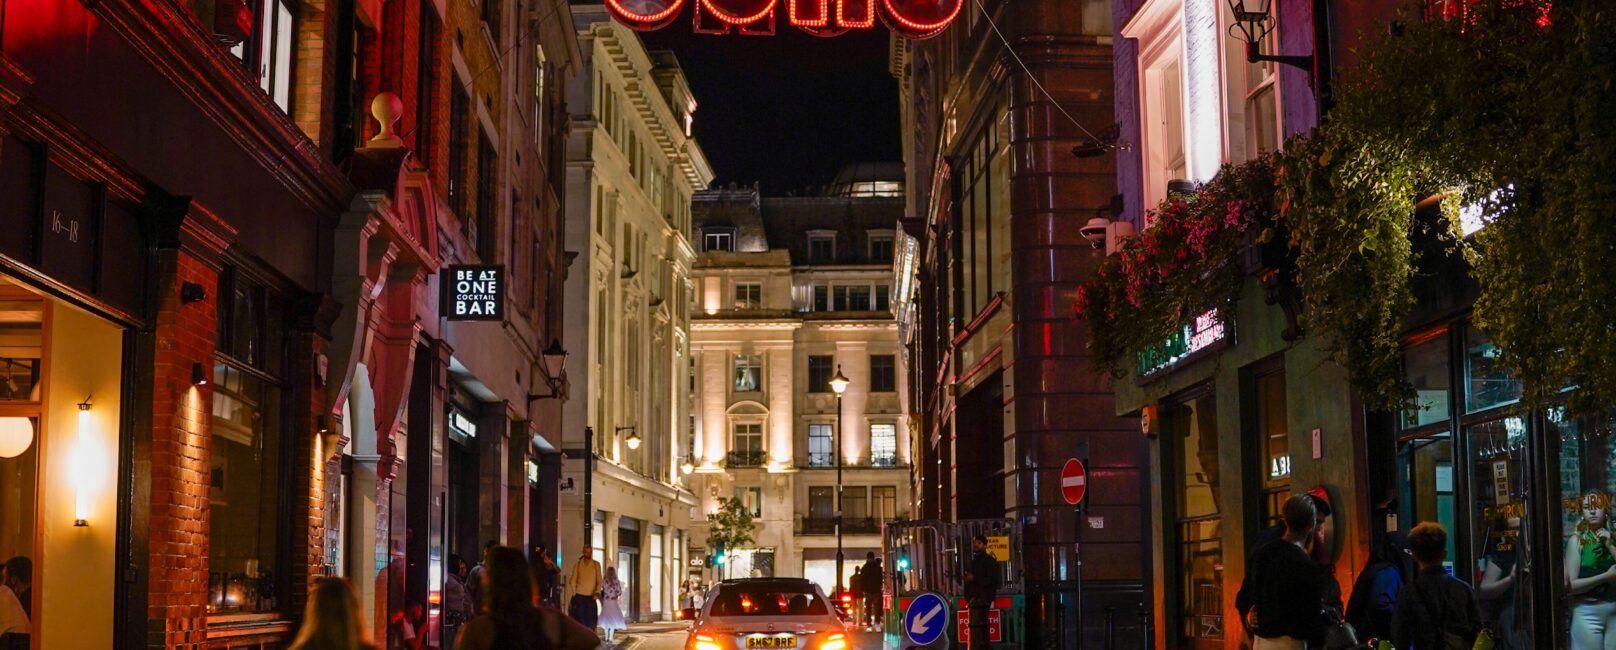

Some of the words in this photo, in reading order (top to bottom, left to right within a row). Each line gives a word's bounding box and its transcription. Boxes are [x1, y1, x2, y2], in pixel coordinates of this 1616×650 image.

[457, 270, 473, 280] BE
[479, 270, 496, 281] AT
[457, 281, 496, 294] ONE
[456, 301, 496, 315] BAR
